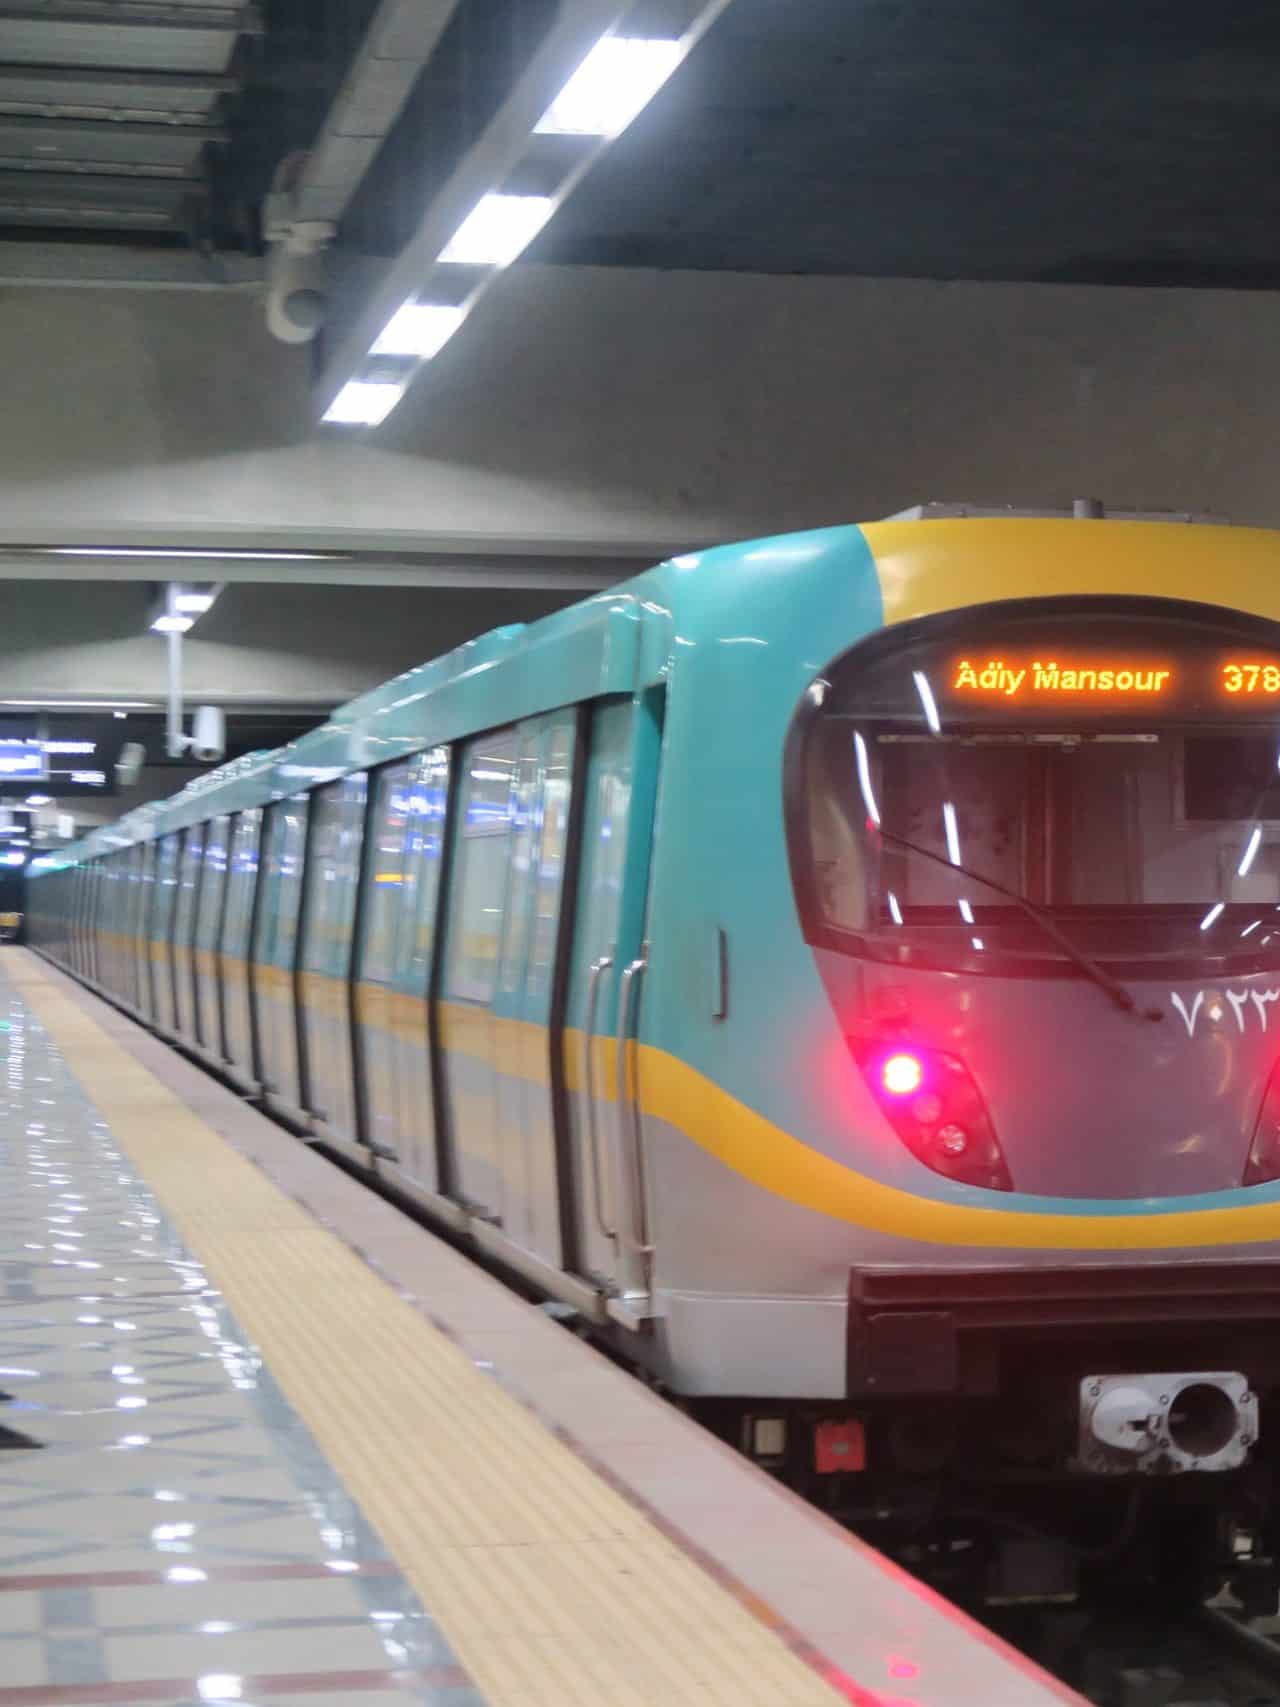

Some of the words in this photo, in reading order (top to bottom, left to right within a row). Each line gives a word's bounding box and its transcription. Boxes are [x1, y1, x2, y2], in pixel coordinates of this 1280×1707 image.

[1032, 661, 1170, 691] Mansour
[1223, 664, 1280, 692] 378
[1170, 988, 1280, 1039] ٧٠٢٣
